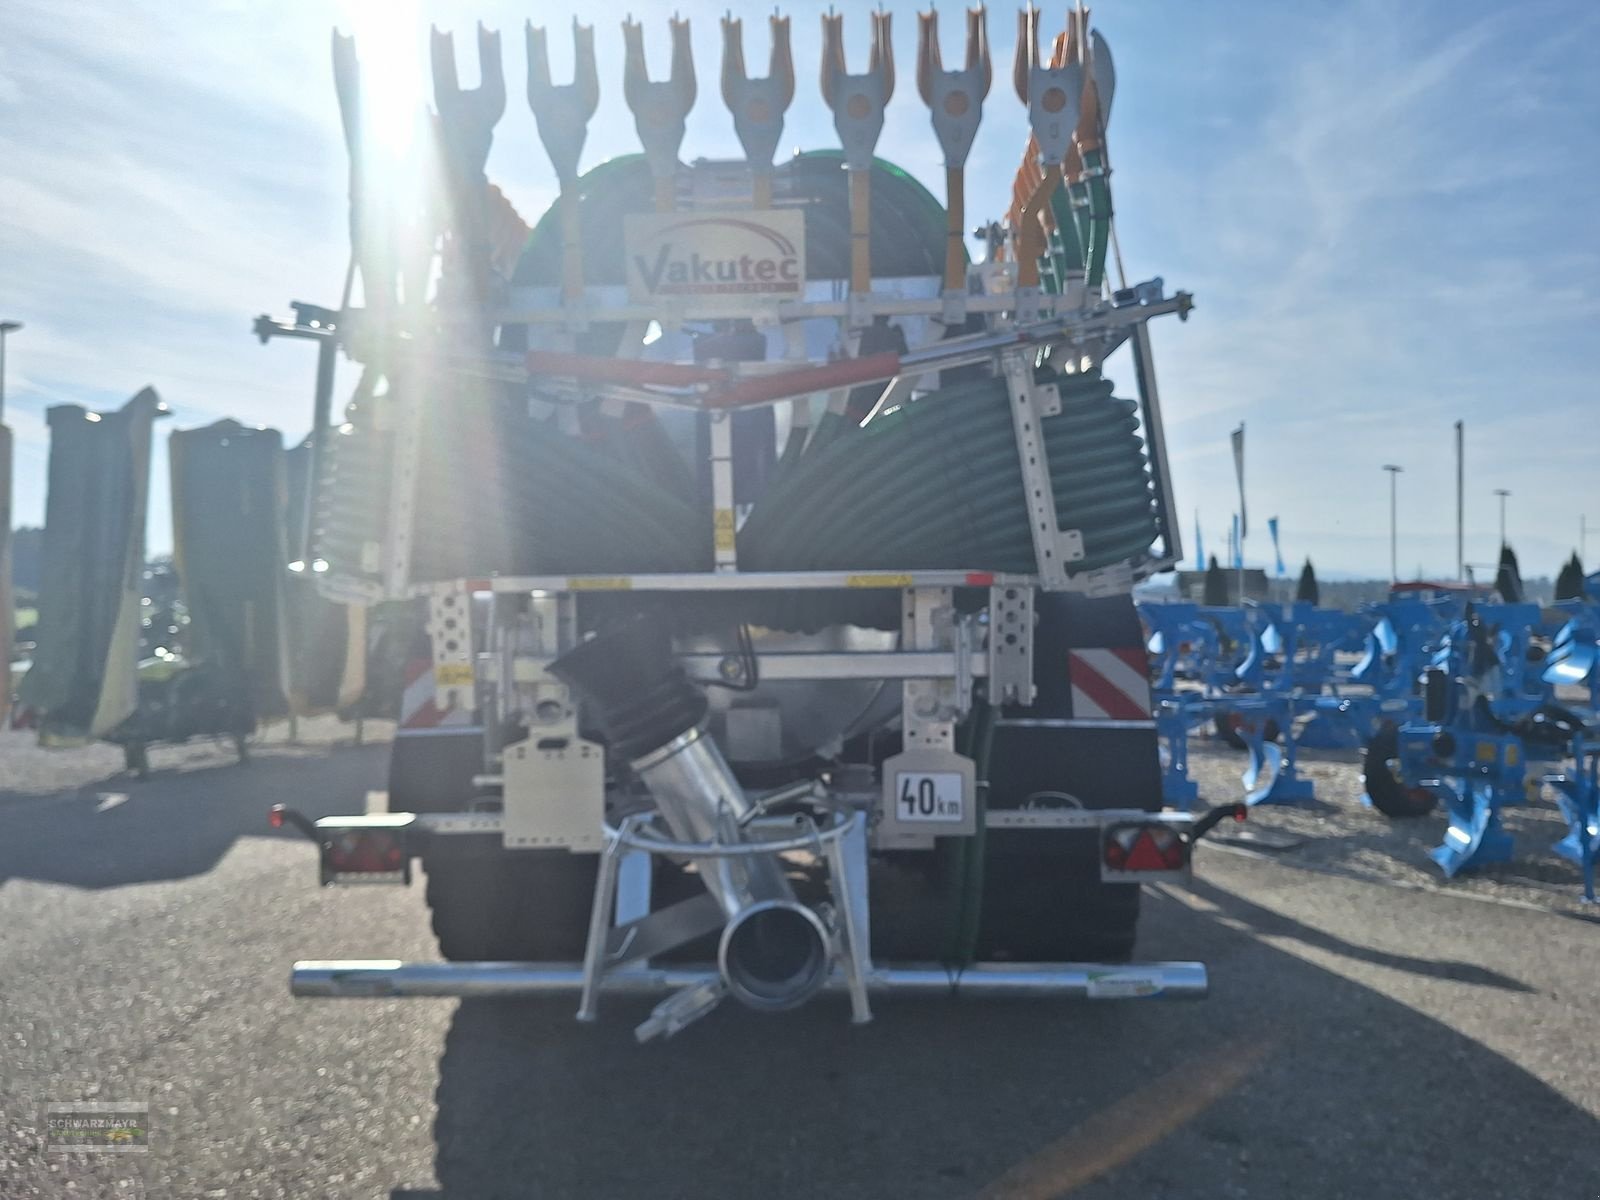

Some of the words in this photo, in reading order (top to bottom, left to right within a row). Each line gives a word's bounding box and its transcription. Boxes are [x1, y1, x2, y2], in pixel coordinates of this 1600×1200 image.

[633, 243, 799, 292] Vakutec
[901, 777, 934, 816] 40
[937, 797, 959, 815] km
